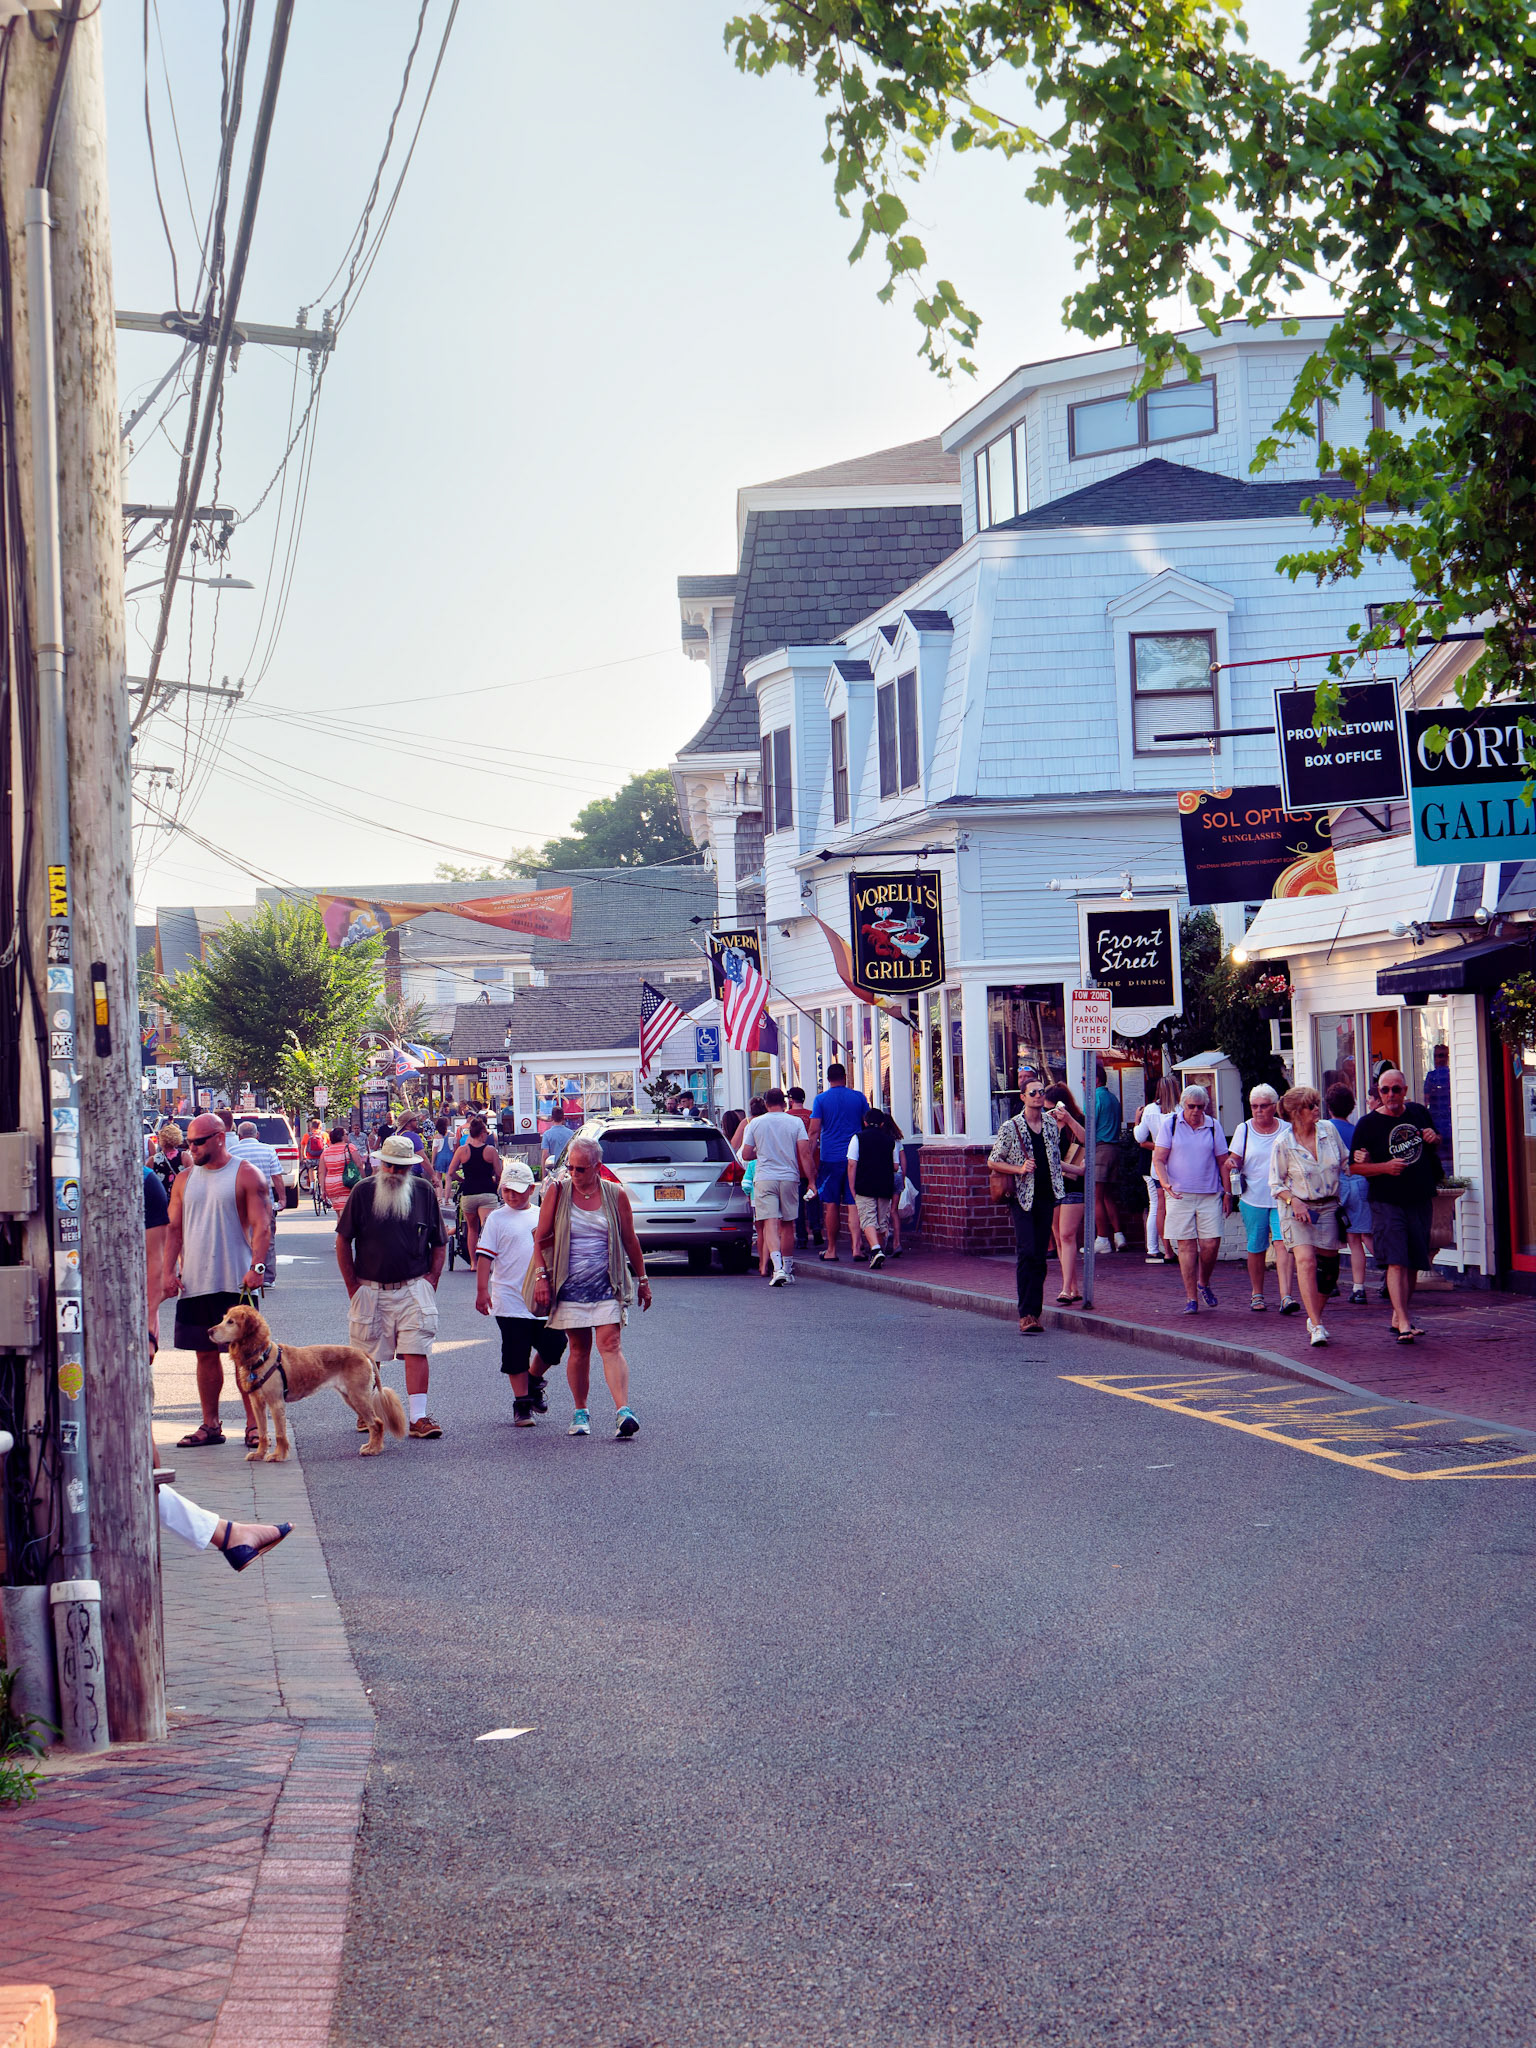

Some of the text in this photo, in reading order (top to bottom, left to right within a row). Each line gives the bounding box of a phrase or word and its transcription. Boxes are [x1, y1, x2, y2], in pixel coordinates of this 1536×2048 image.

[1304, 749, 1382, 768] BOX OFFICE
[1202, 811, 1240, 829] SOL
[1421, 797, 1536, 842] GALL
[1221, 831, 1282, 843] SUNGLASSES
[856, 884, 937, 911] VORELLI'S
[1096, 927, 1163, 954] Front
[1100, 948, 1159, 973] Street
[865, 960, 933, 979] GRILLE
[1097, 979, 1166, 988] FINE DINING
[1074, 991, 1109, 1000] TOW ZONE
[1085, 1005, 1098, 1013] NO
[1074, 1015, 1109, 1024] PARKING
[1076, 1026, 1107, 1034] EITHER
[51, 1035, 73, 1046] INFO
[1082, 1036, 1101, 1044] SIDE
[52, 1045, 74, 1056] WARS
[1389, 1135, 1423, 1155] GUINNESS
